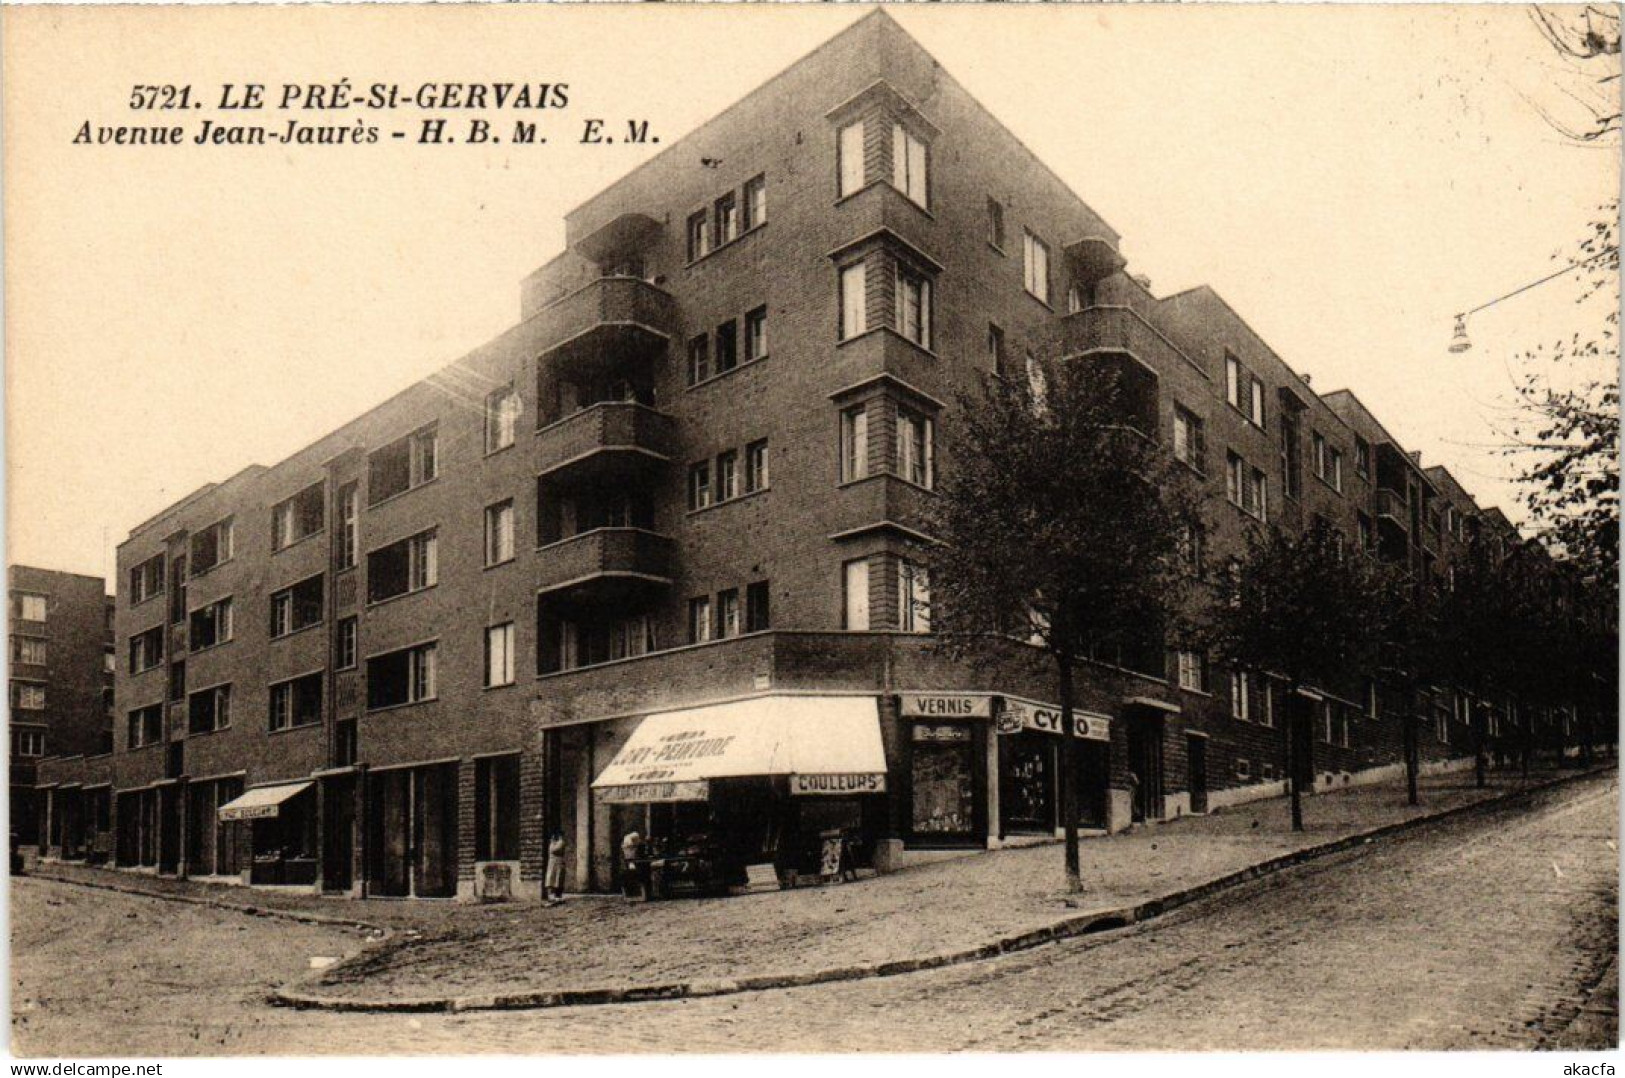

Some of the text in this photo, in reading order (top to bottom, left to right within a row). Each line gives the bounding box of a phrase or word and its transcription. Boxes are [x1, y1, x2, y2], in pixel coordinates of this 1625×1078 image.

[917, 696, 973, 714] VERNIS
[1033, 708, 1090, 736] CYO
[799, 774, 877, 791] COULEURS
